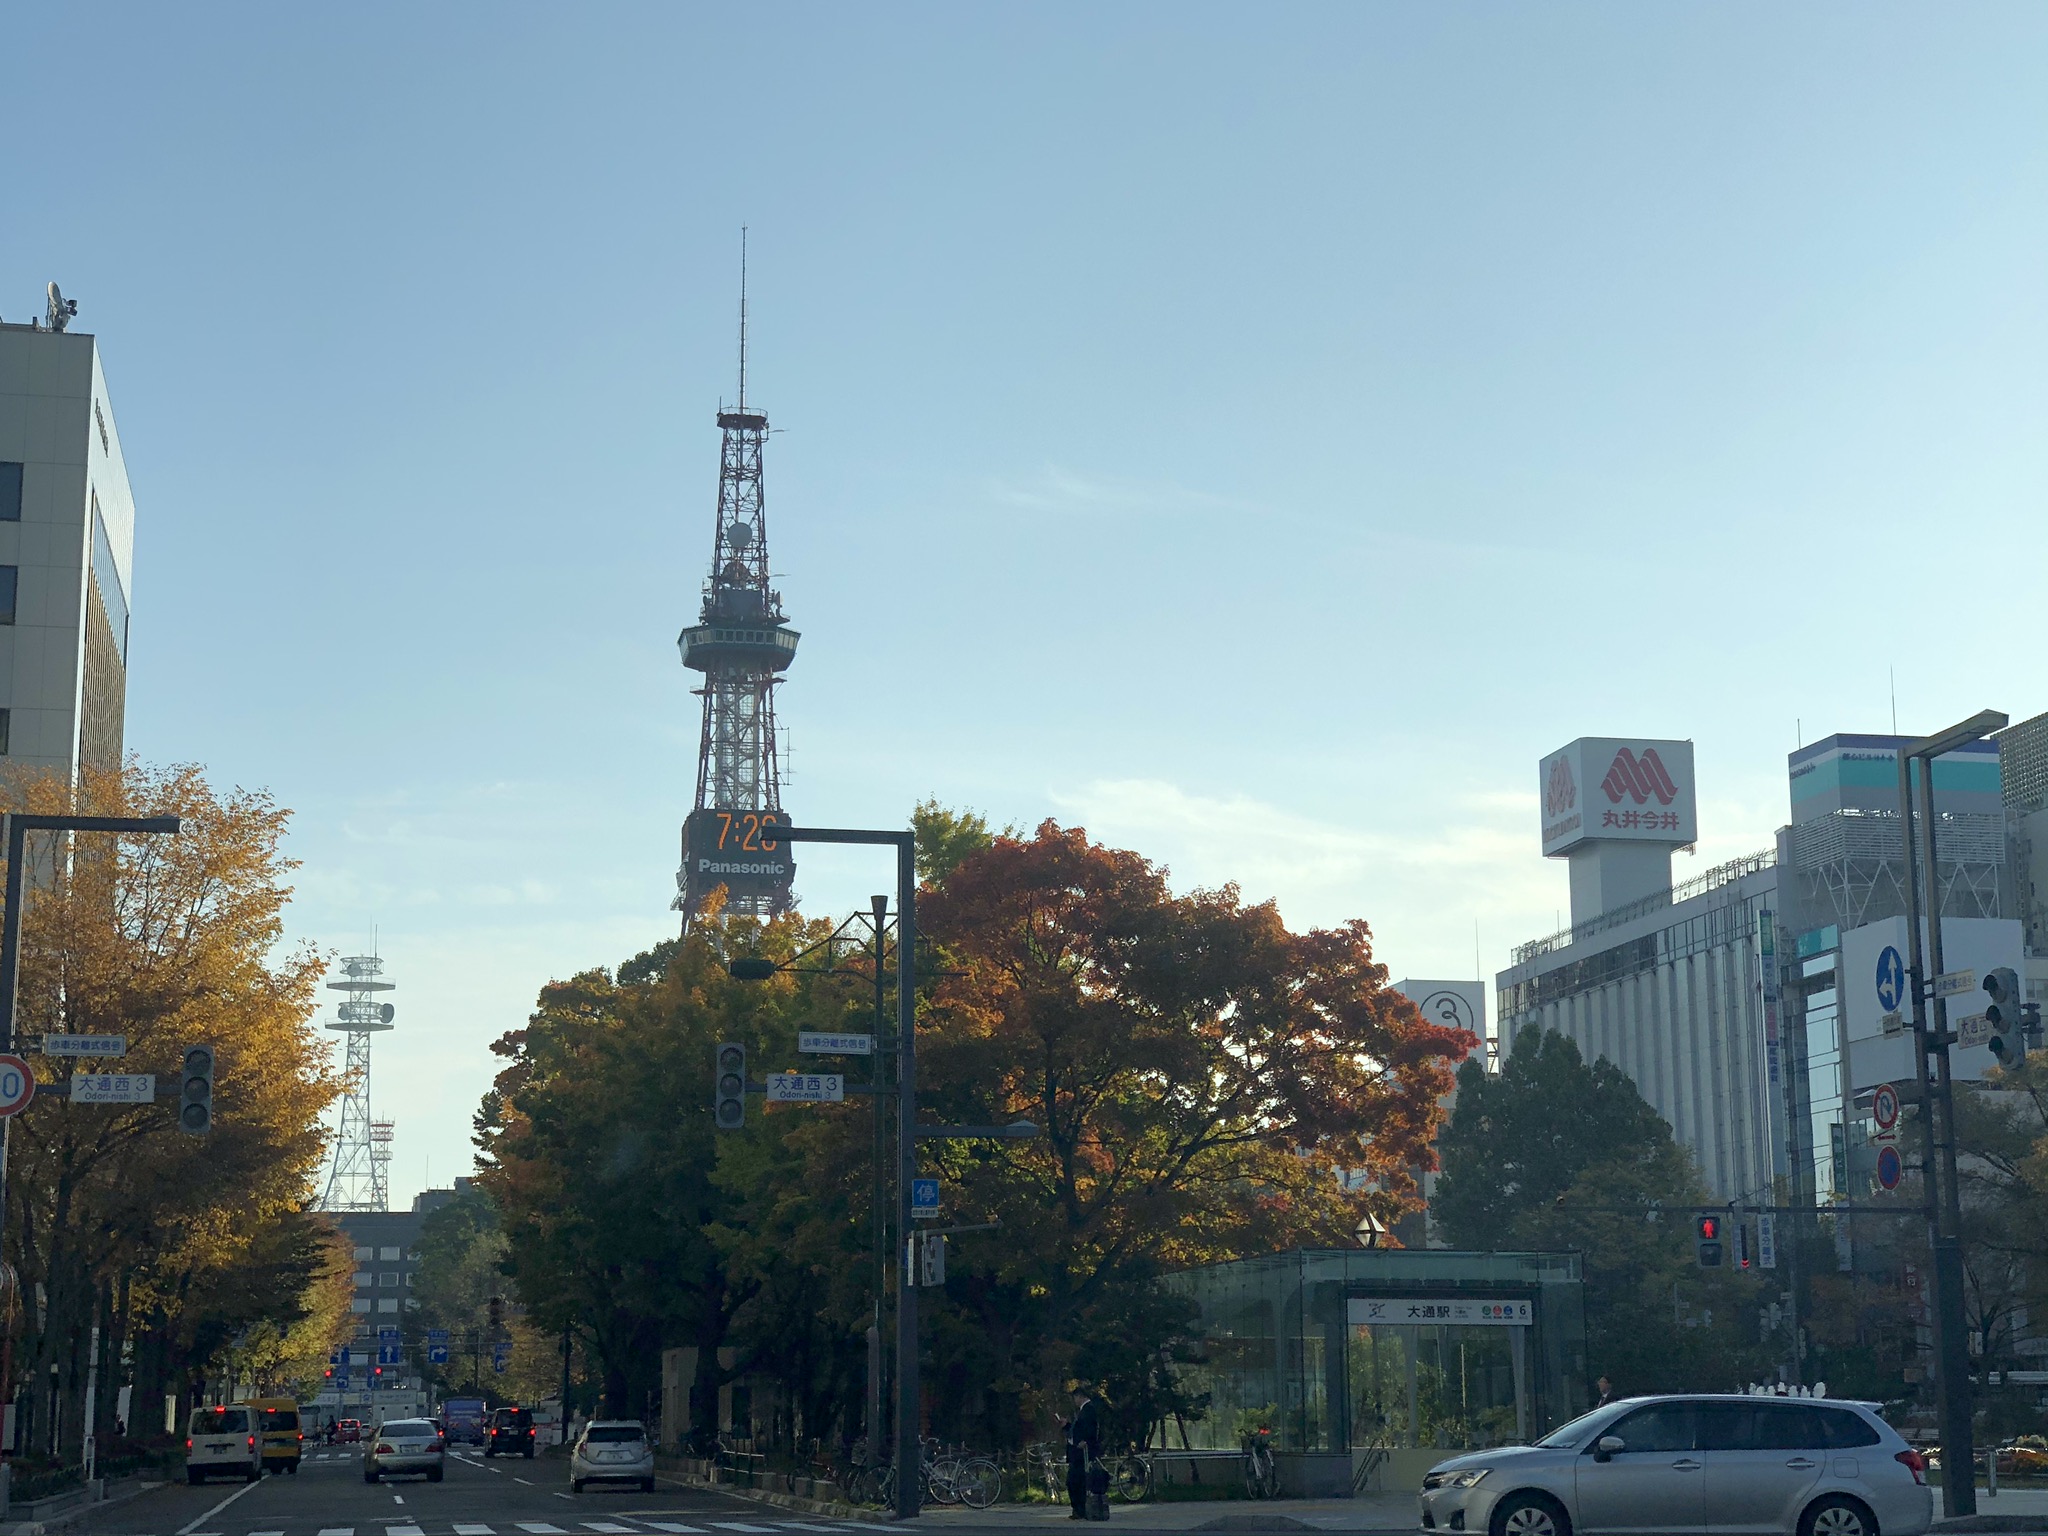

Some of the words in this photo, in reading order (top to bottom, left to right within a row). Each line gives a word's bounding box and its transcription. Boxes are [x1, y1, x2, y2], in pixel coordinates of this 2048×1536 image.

[1602, 809, 1680, 831] 丸井今井
[698, 859, 785, 874] Panasonic
[50, 1040, 122, 1051] 歩車分離式信号
[803, 1038, 866, 1049] 歩車分離式信号
[0, 1072, 20, 1099] 0
[85, 1092, 131, 1100] Odori-nishi
[779, 1091, 823, 1099] Odori-nishi
[917, 1184, 935, 1202] 停
[1407, 1305, 1450, 1318] 大通駅
[1520, 1305, 1526, 1315] 6
